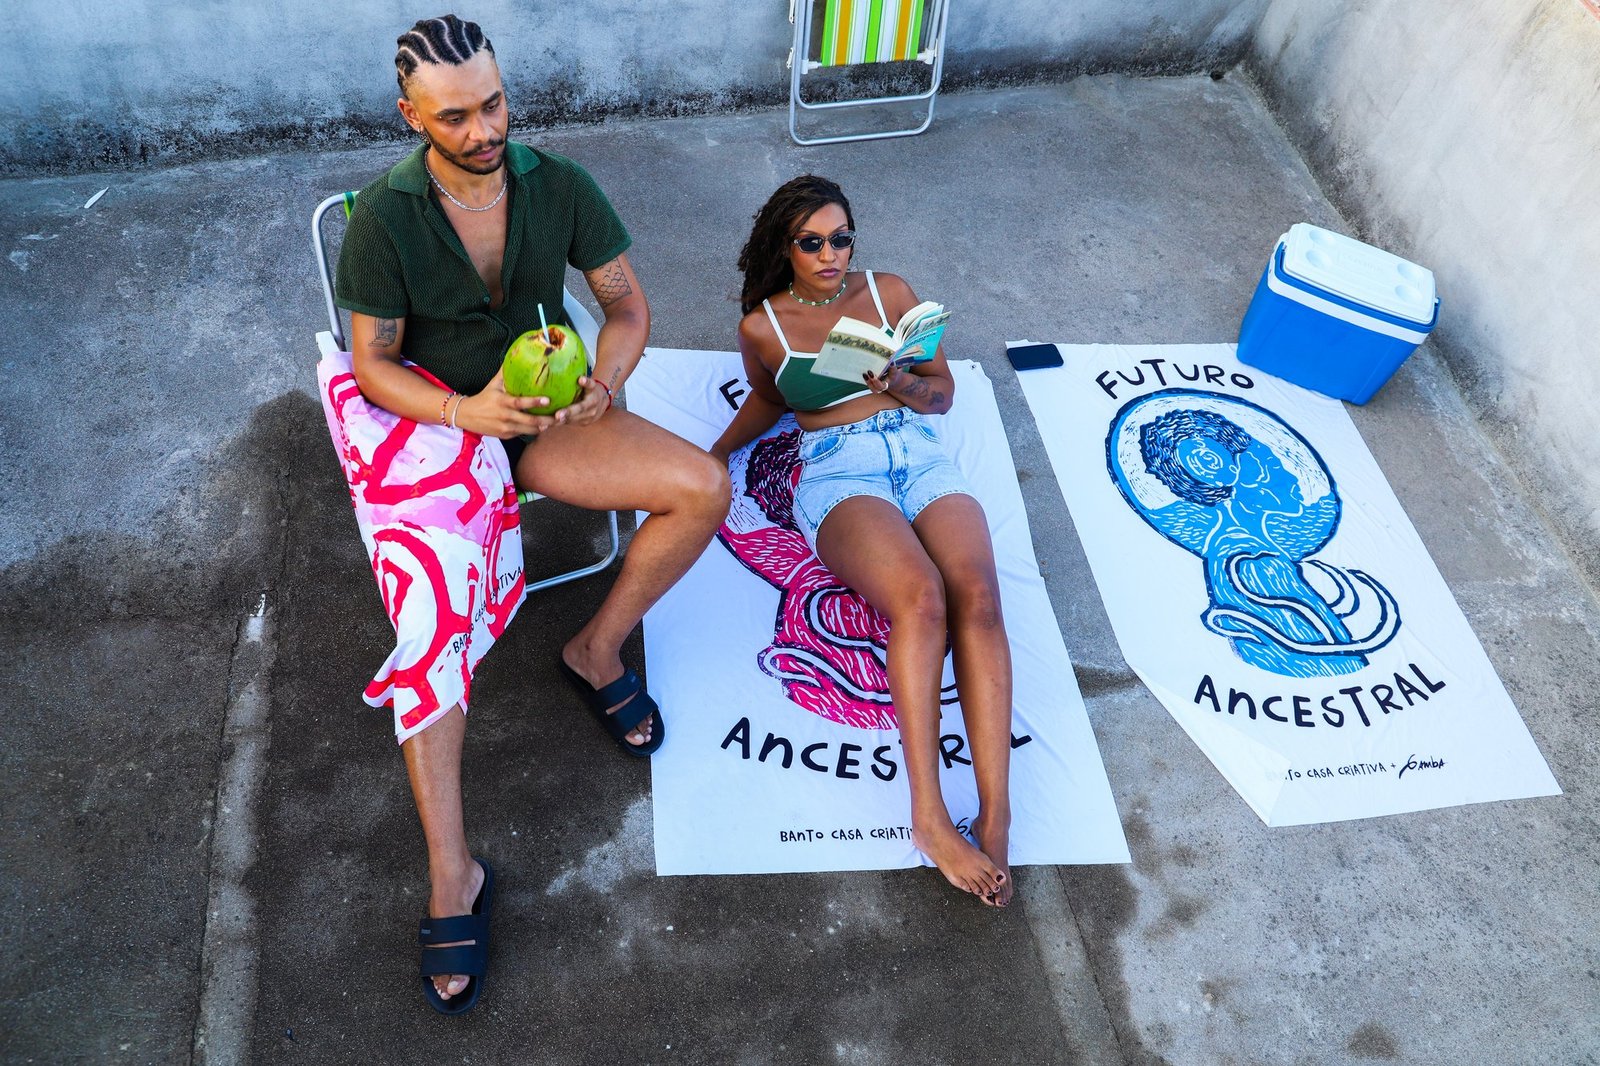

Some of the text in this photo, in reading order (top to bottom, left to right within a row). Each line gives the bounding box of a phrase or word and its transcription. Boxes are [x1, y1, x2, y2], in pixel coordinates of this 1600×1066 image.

[1095, 358, 1254, 400] FUTURO
[1306, 767, 1335, 779] CASA
[831, 829, 863, 841] CASA
